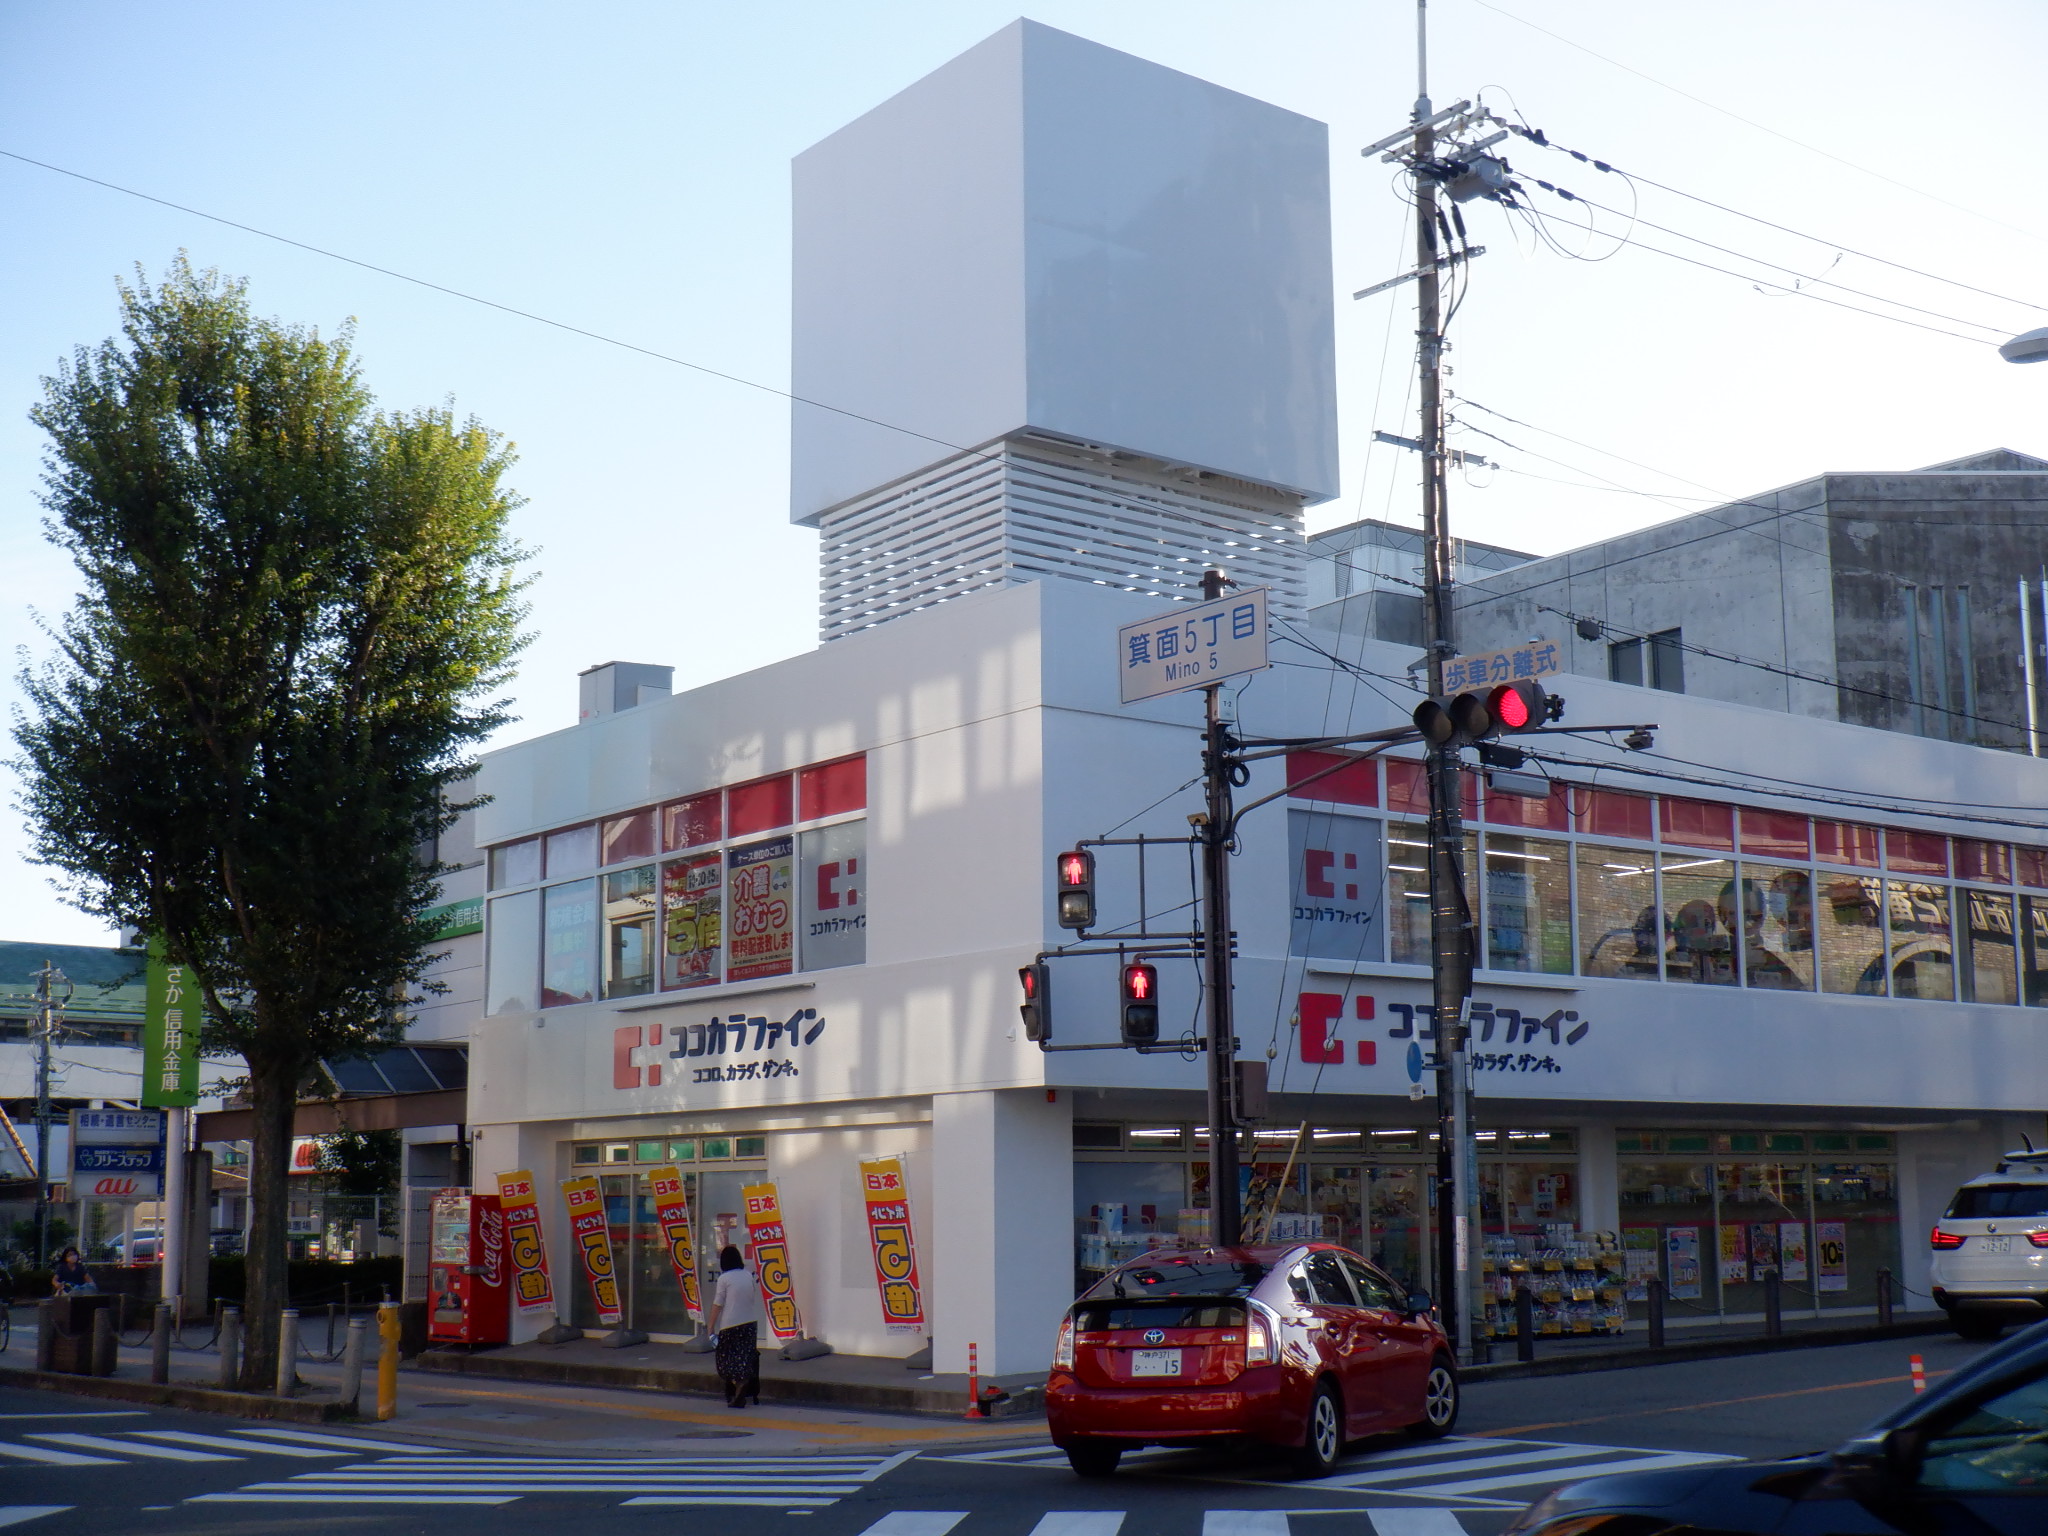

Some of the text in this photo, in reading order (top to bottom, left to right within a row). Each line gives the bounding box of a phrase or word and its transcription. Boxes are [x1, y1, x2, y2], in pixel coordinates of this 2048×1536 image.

[1129, 603, 1255, 669] 箕面5丁目
[1165, 652, 1218, 682] Mino 5
[1446, 644, 1557, 692] 歩車分離式
[734, 864, 770, 904] 介護
[734, 900, 787, 936] おむつ
[810, 914, 867, 936] ココカラファイン
[1294, 906, 1371, 924] ココカラファイン
[669, 1008, 825, 1059] ココカラファイン
[1388, 1001, 1589, 1045] ココラファイン
[693, 1059, 798, 1083] ココロ、カラダ、ゲンキ。
[94, 1154, 152, 1167] フリーステップ
[94, 1178, 139, 1195] au
